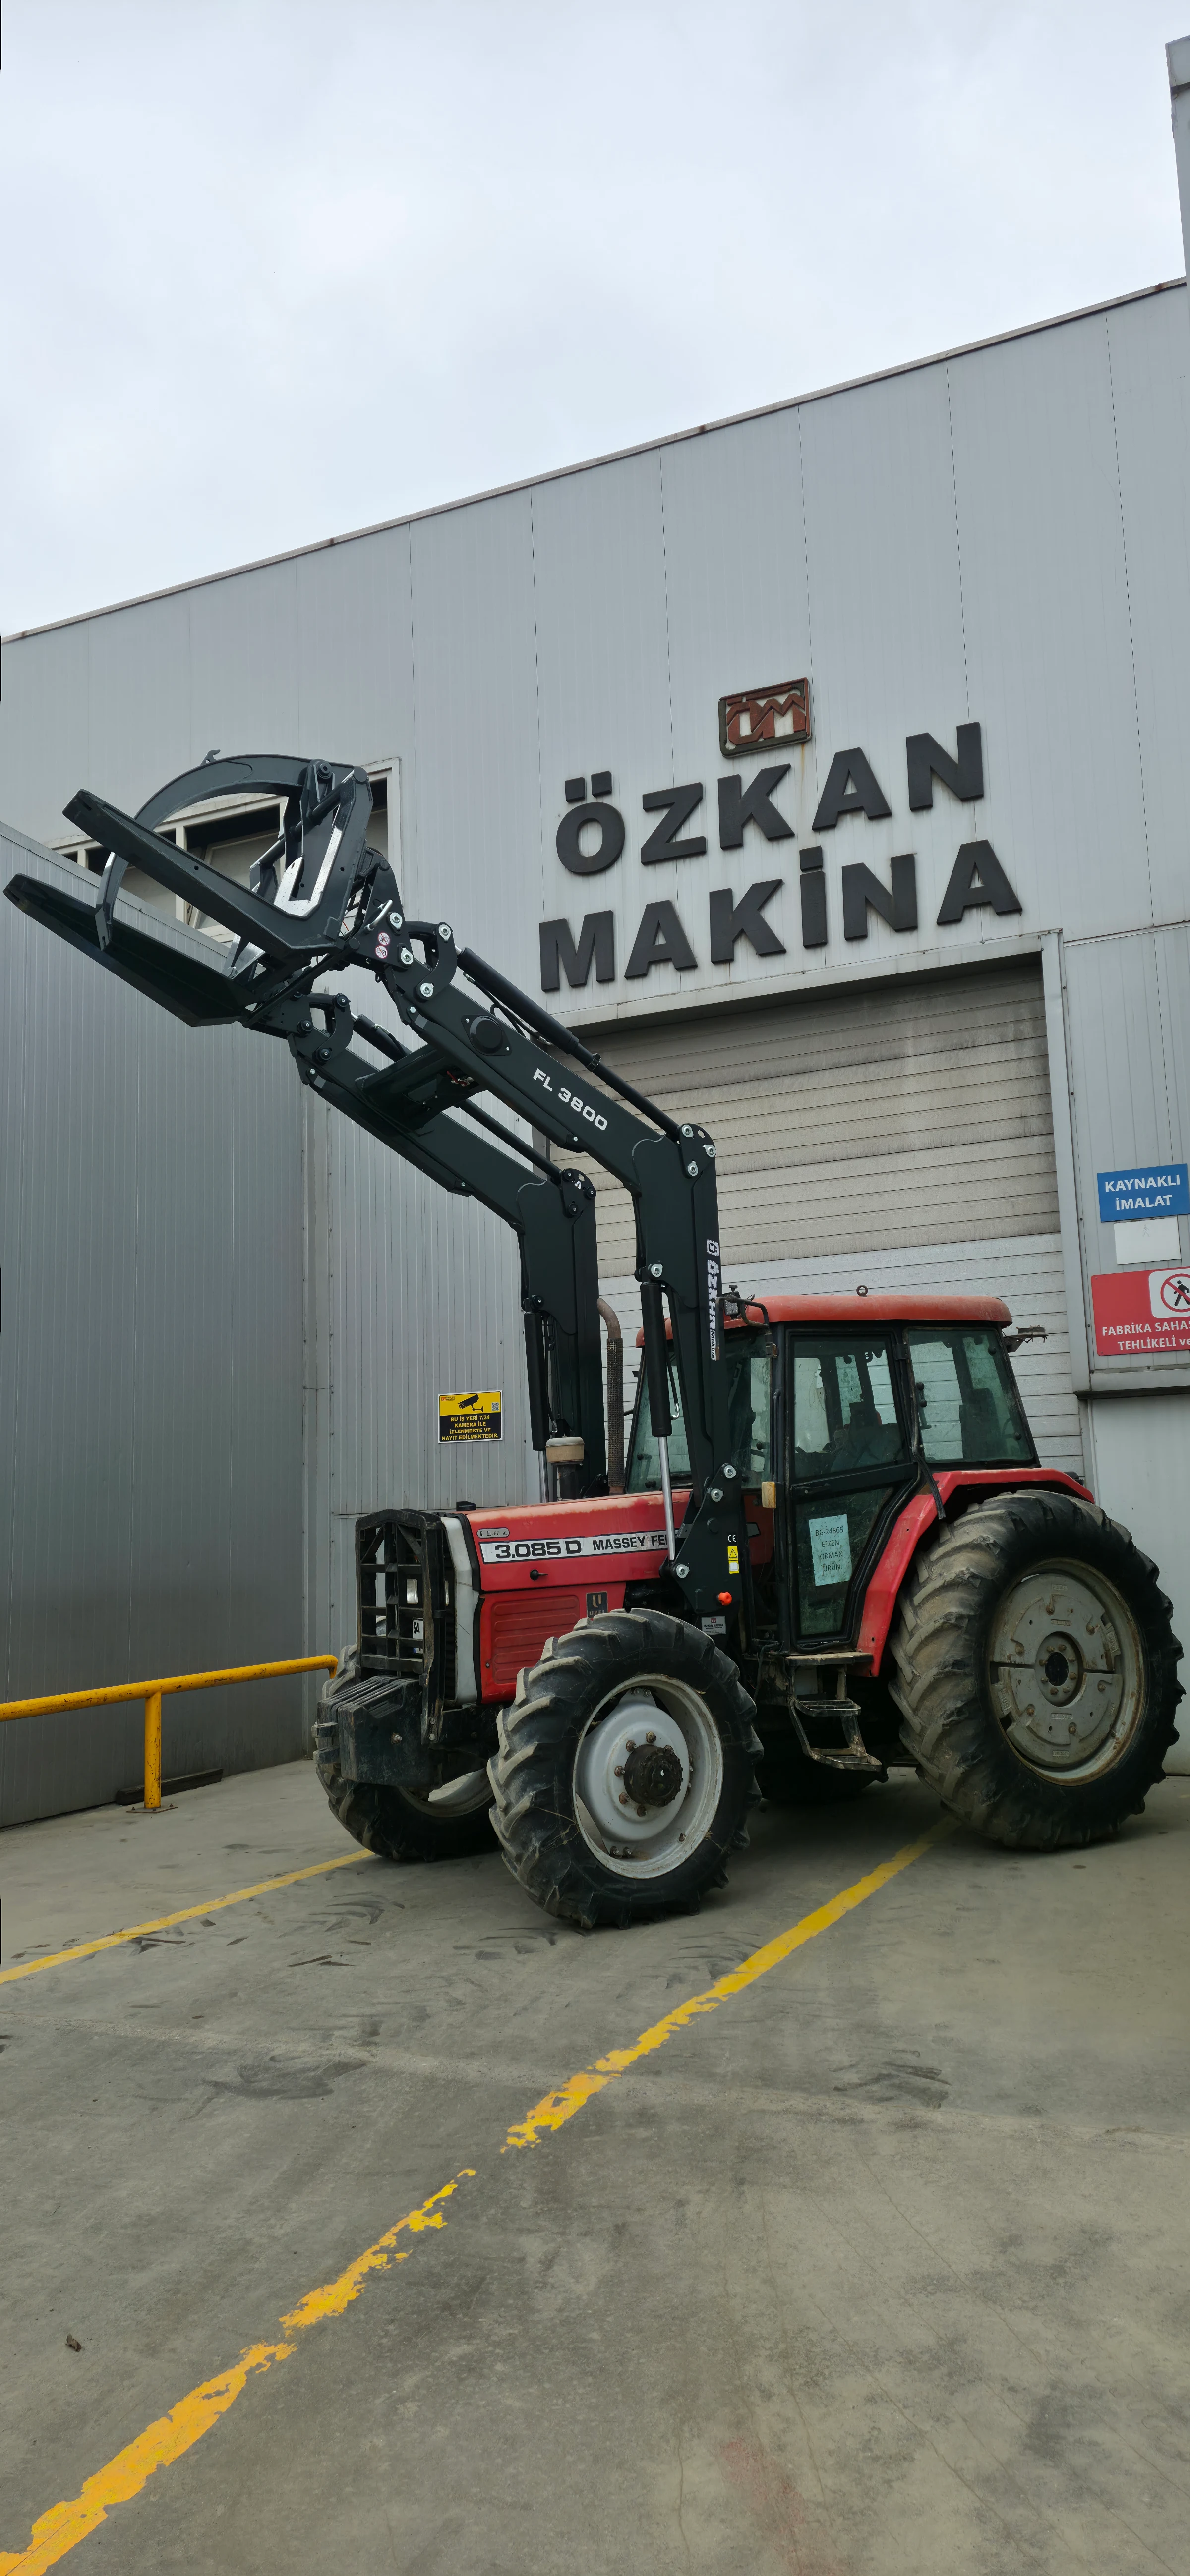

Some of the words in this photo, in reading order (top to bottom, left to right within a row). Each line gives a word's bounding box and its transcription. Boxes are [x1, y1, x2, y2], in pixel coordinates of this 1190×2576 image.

[556, 722, 985, 876] ÖZKAN
[539, 839, 1023, 992] MAKİNA
[533, 1068, 553, 1092] FL
[558, 1088, 608, 1131] 3800
[1105, 1174, 1181, 1192] KAYNAKLI
[1116, 1195, 1173, 1210] İMALAT
[1102, 1322, 1152, 1336] FABRİKA
[1118, 1335, 1177, 1350] TEHLİKELİ
[816, 1525, 844, 1536] BG-24865
[495, 1541, 562, 1559] 3.085
[565, 1540, 582, 1554] D
[593, 1535, 646, 1551] MASSEY
[651, 1534, 668, 1546] FE
[822, 1539, 839, 1547] EFZEN
[820, 1551, 843, 1560] ORMAN
[413, 1622, 420, 1635] 54
